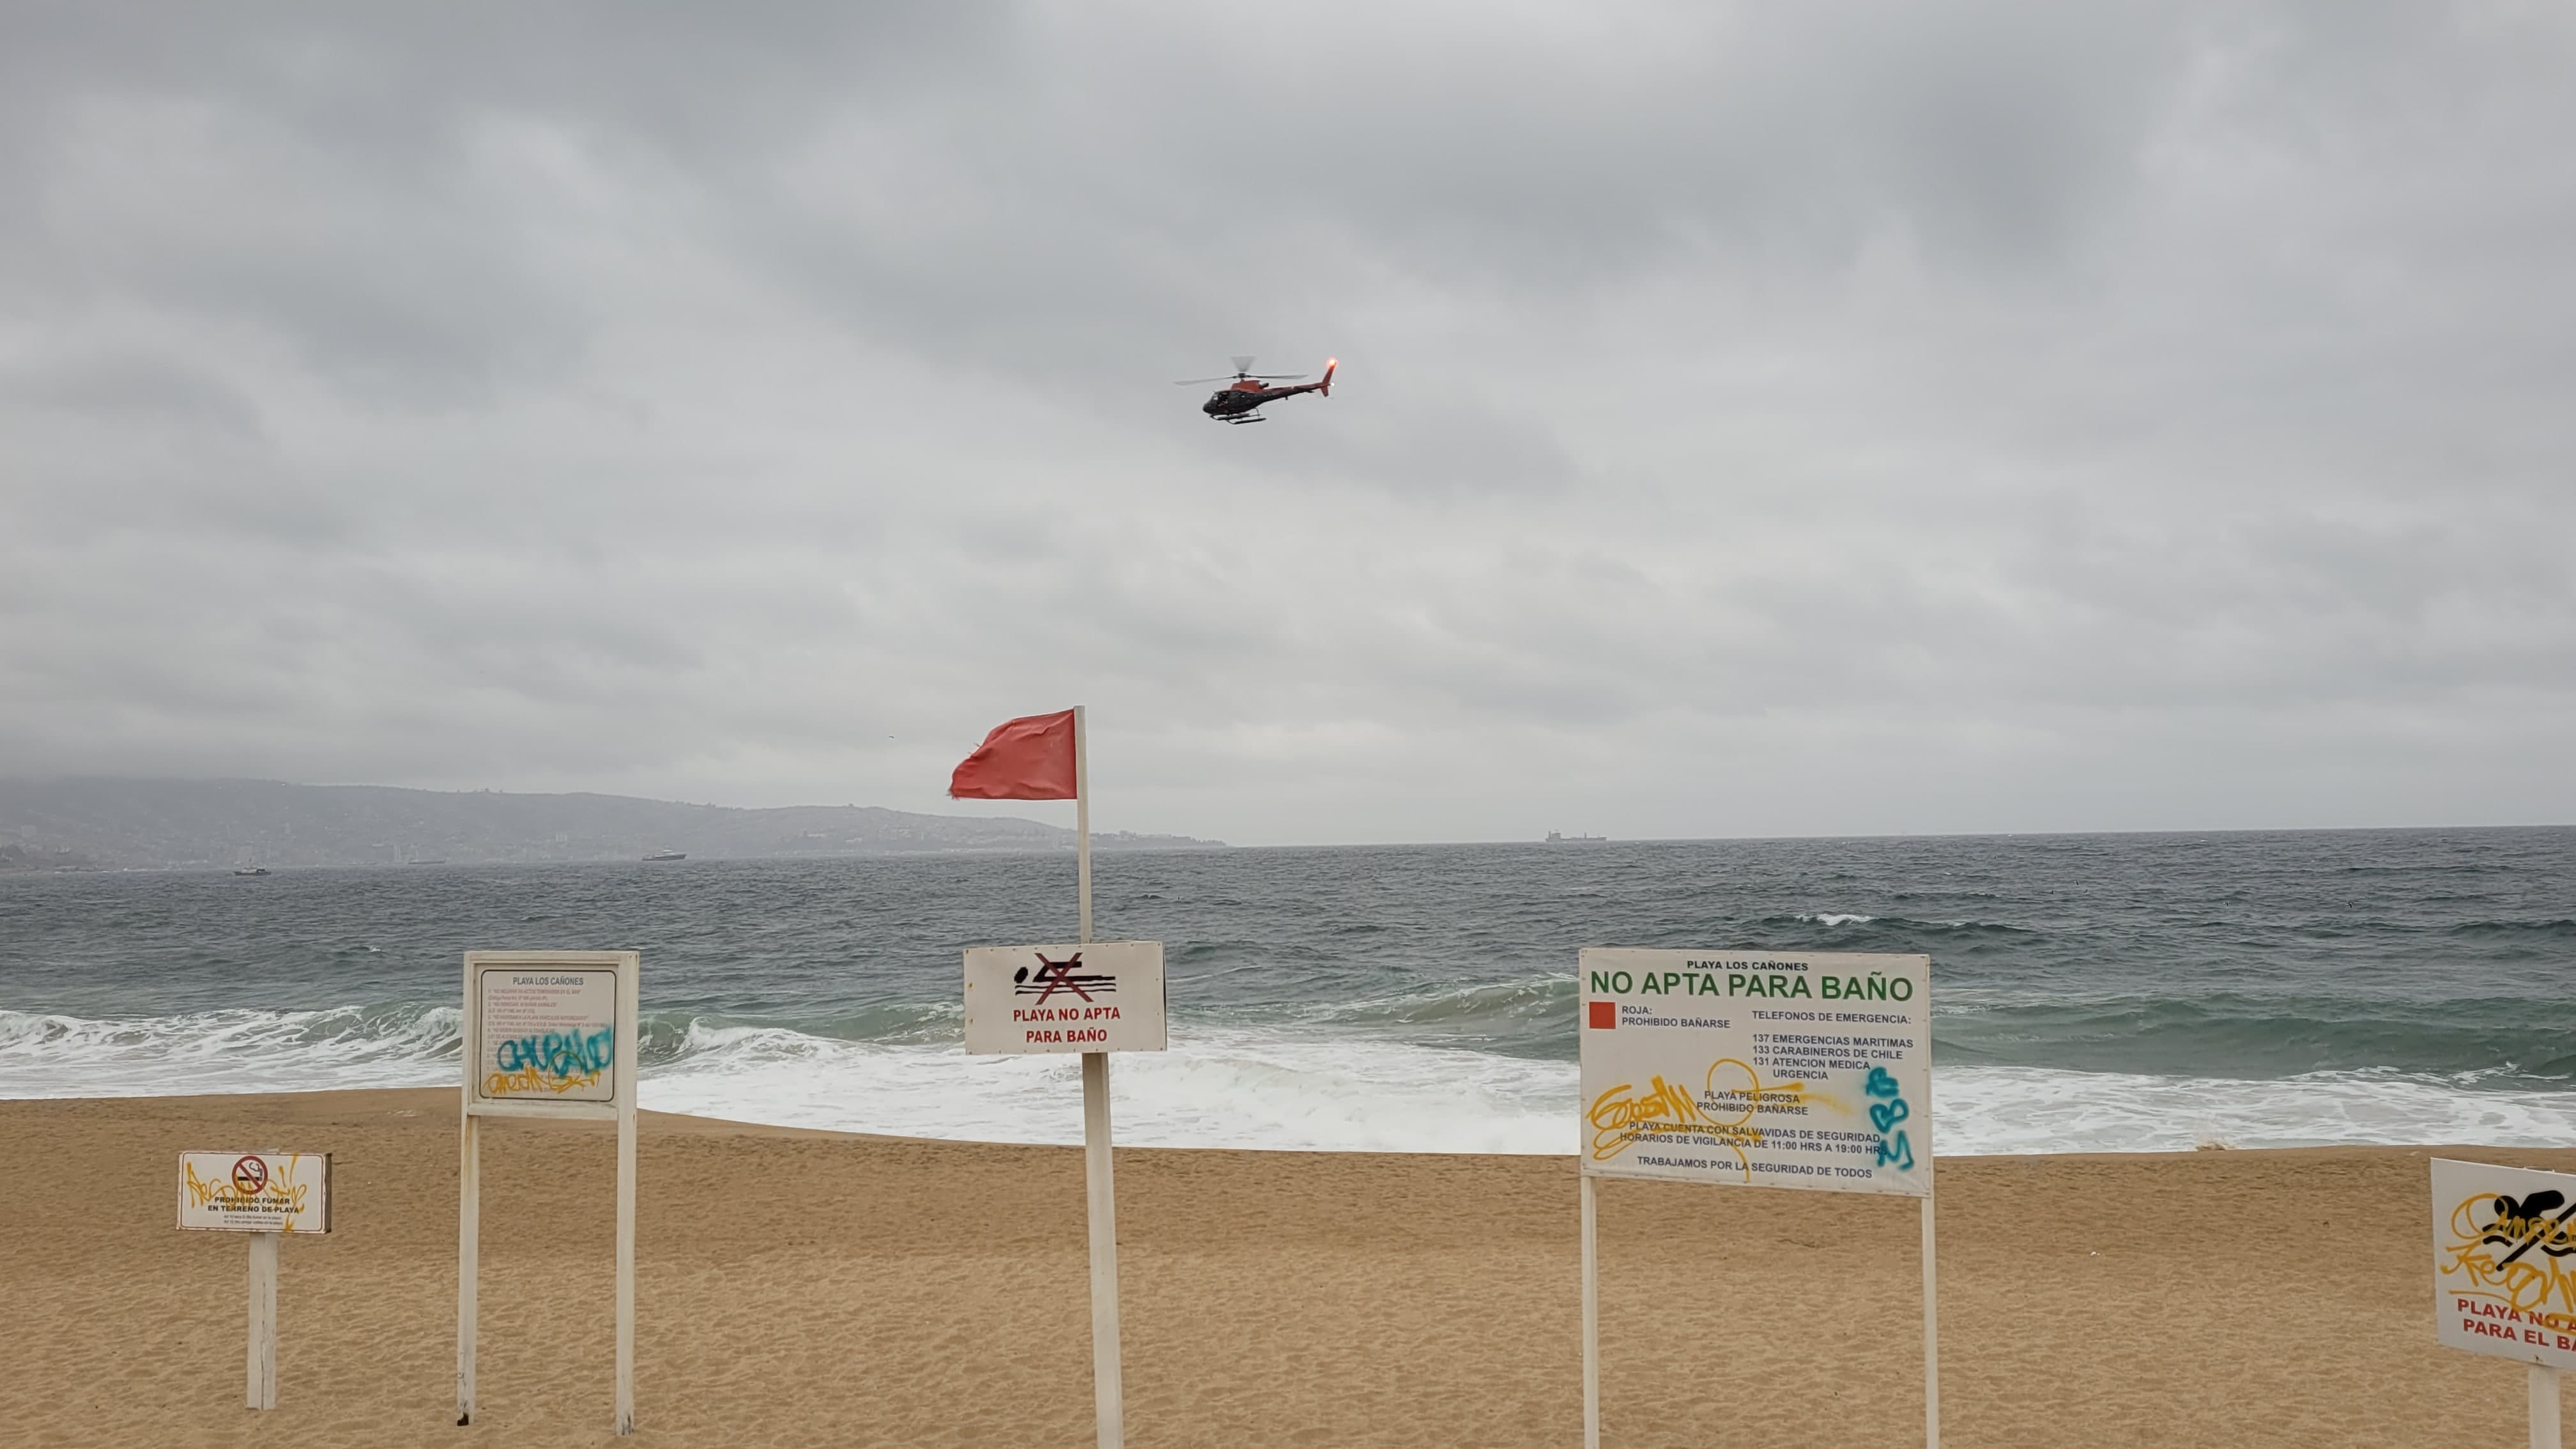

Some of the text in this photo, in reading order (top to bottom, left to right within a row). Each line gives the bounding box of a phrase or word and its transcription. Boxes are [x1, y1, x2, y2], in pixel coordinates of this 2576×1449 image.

[1687, 960, 1809, 970] PLAYA LOS CAÑONES
[512, 976, 583, 986] PLAYA LOS CAÑONES
[1591, 970, 1913, 1002] NO APTA PARA BAÑO
[1013, 1007, 1121, 1022] PLAYA NO APTA
[1621, 1006, 1653, 1015] ROJA:
[1752, 1010, 1912, 1024] TELEFONOS DE EMERGENCIA:
[1621, 1017, 1731, 1029] PROHIBIDO BAÑARSE
[1026, 1027, 1107, 1043] PARA BAÑO
[1753, 1034, 1913, 1048] 137 EMERGENCIAS MARITIMAS
[1753, 1045, 1903, 1060] 133 CARABINEROS DE CHILE
[1753, 1057, 1871, 1070] 131 ATENCION MEDICA
[1773, 1069, 1828, 1080] URGENCIA
[1704, 1091, 1800, 1103] PLAYA PELIGROSA
[1697, 1101, 1809, 1116] PROHIBIDO BAÑARSE
[1629, 1121, 1880, 1143] PLAYA CUENTA CON SALVAVIDAS DE SEGURIDAD
[1620, 1133, 1888, 1155] HORARIOS DE VIGILANCIA DE 11:00 HRS A 19:00 HRS
[1637, 1156, 1872, 1178] TRABAJAMOS POR LA SEGURIDAD DE TODOS
[2458, 1298, 2522, 1322] PLAYA
[2529, 1311, 2559, 1328] NO
[2464, 1318, 2517, 1341] PARA
[2524, 1329, 2550, 1347] EL
